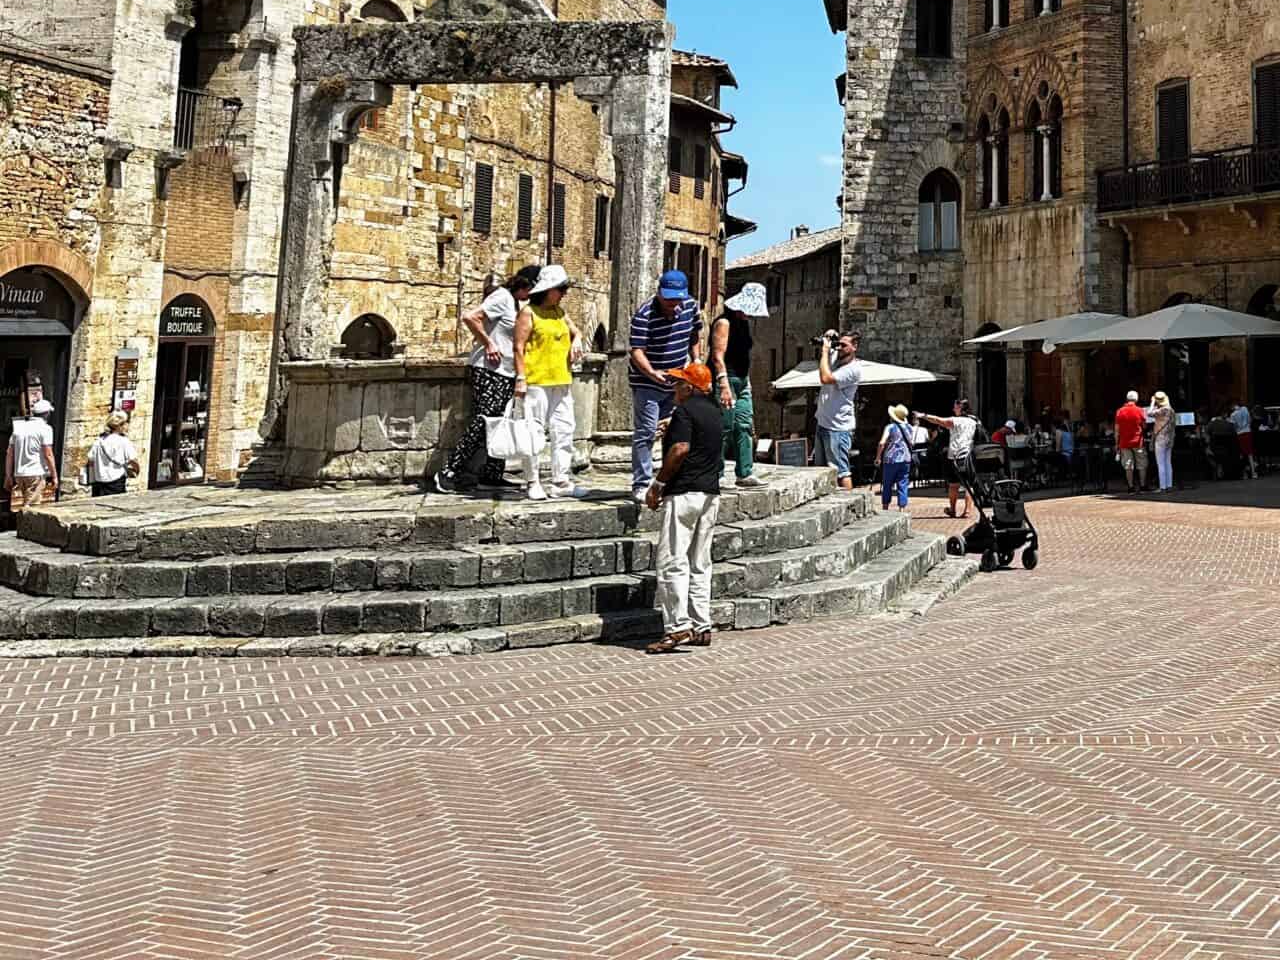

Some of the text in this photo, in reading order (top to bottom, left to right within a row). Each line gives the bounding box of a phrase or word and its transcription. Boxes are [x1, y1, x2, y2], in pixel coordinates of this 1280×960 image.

[0, 282, 44, 303] Vinaio
[170, 306, 202, 318] TRUFFLE
[167, 321, 203, 333] BOUTIQUE
